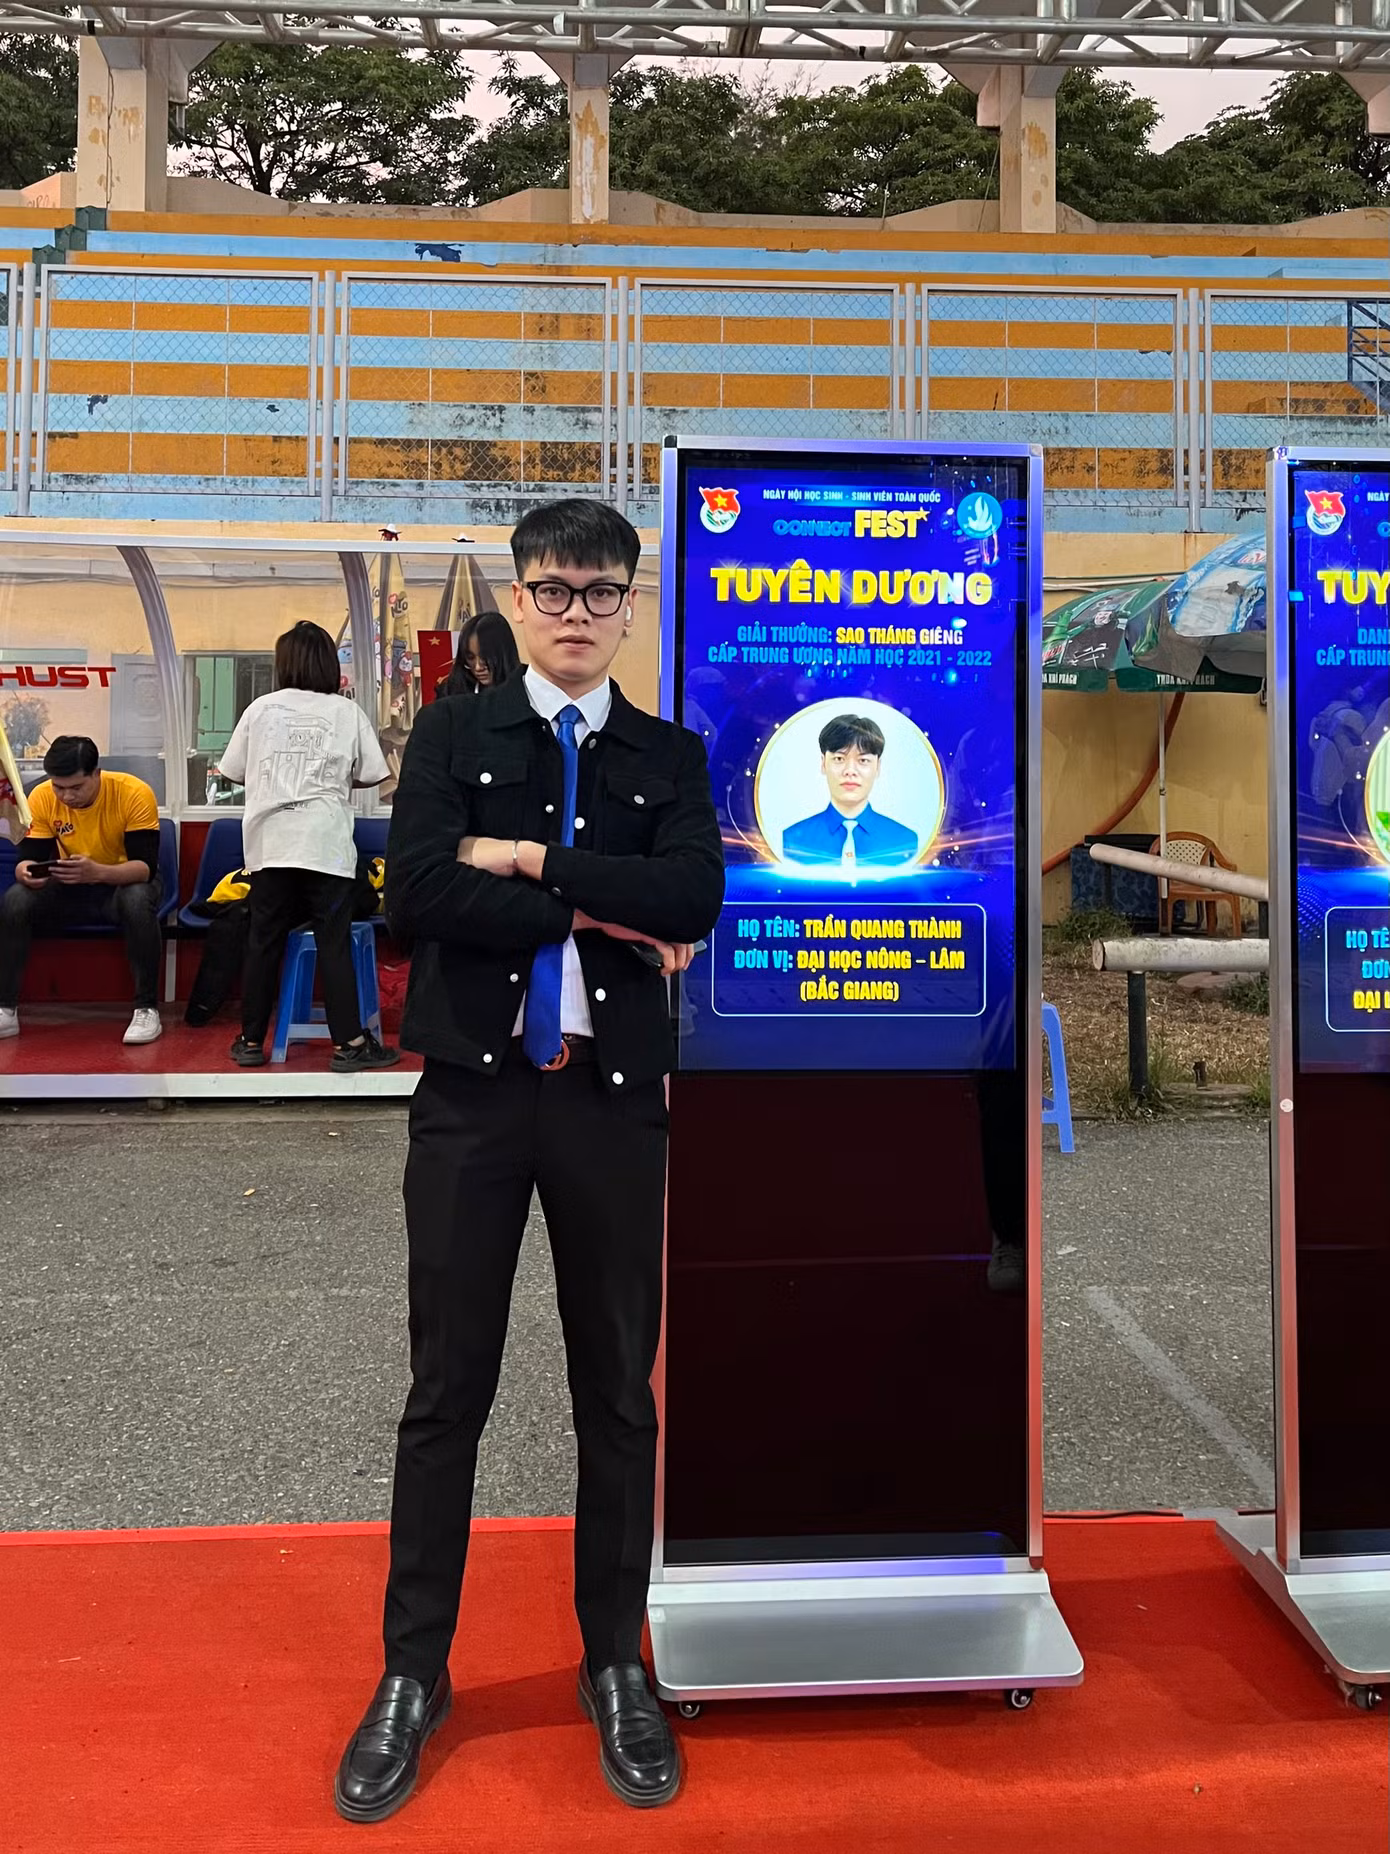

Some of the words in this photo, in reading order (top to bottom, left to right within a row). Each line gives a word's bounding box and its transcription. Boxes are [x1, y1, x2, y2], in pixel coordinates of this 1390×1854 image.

[763, 487, 786, 500] NGÀY
[788, 489, 802, 502] HỘI
[804, 490, 821, 503] HỌC
[823, 491, 844, 500] SINH
[851, 491, 872, 501] SINH
[873, 489, 893, 502] VIÊN
[894, 489, 917, 503] TOÀN
[918, 489, 941, 503] QUỐC
[854, 509, 921, 538] FEST
[710, 558, 841, 604] TUYÊN
[852, 569, 993, 606] DƯƠNG
[737, 620, 767, 643] GIẢI
[770, 620, 833, 644] THƯỞNG:
[836, 626, 865, 644] SAO
[868, 624, 916, 645] THÁNG
[919, 625, 963, 645] GIÊNG
[708, 640, 736, 664] CẤP
[741, 647, 790, 664] TRUNG
[837, 645, 871, 666] NĂM
[875, 648, 904, 669] HỌC
[907, 649, 941, 666] 2021
[956, 650, 992, 667] 2022
[1316, 644, 1346, 667] CẤP
[737, 918, 760, 942] HỌ
[764, 915, 800, 939] TÊN:
[803, 913, 847, 939] TRẦN
[850, 919, 905, 941] QUANG
[909, 916, 962, 939] THÀNH
[1346, 930, 1368, 953] HỌ
[734, 948, 769, 969] ĐƠN
[772, 950, 793, 973] VỊ:
[797, 950, 825, 973] ĐẠI
[828, 950, 862, 973] HỌC
[866, 946, 912, 970] NÔNG
[930, 947, 965, 970] LÂM
[800, 974, 839, 1002] (BẮC
[843, 980, 900, 1002] GIANG)
[1353, 990, 1381, 1013] ĐẠI
